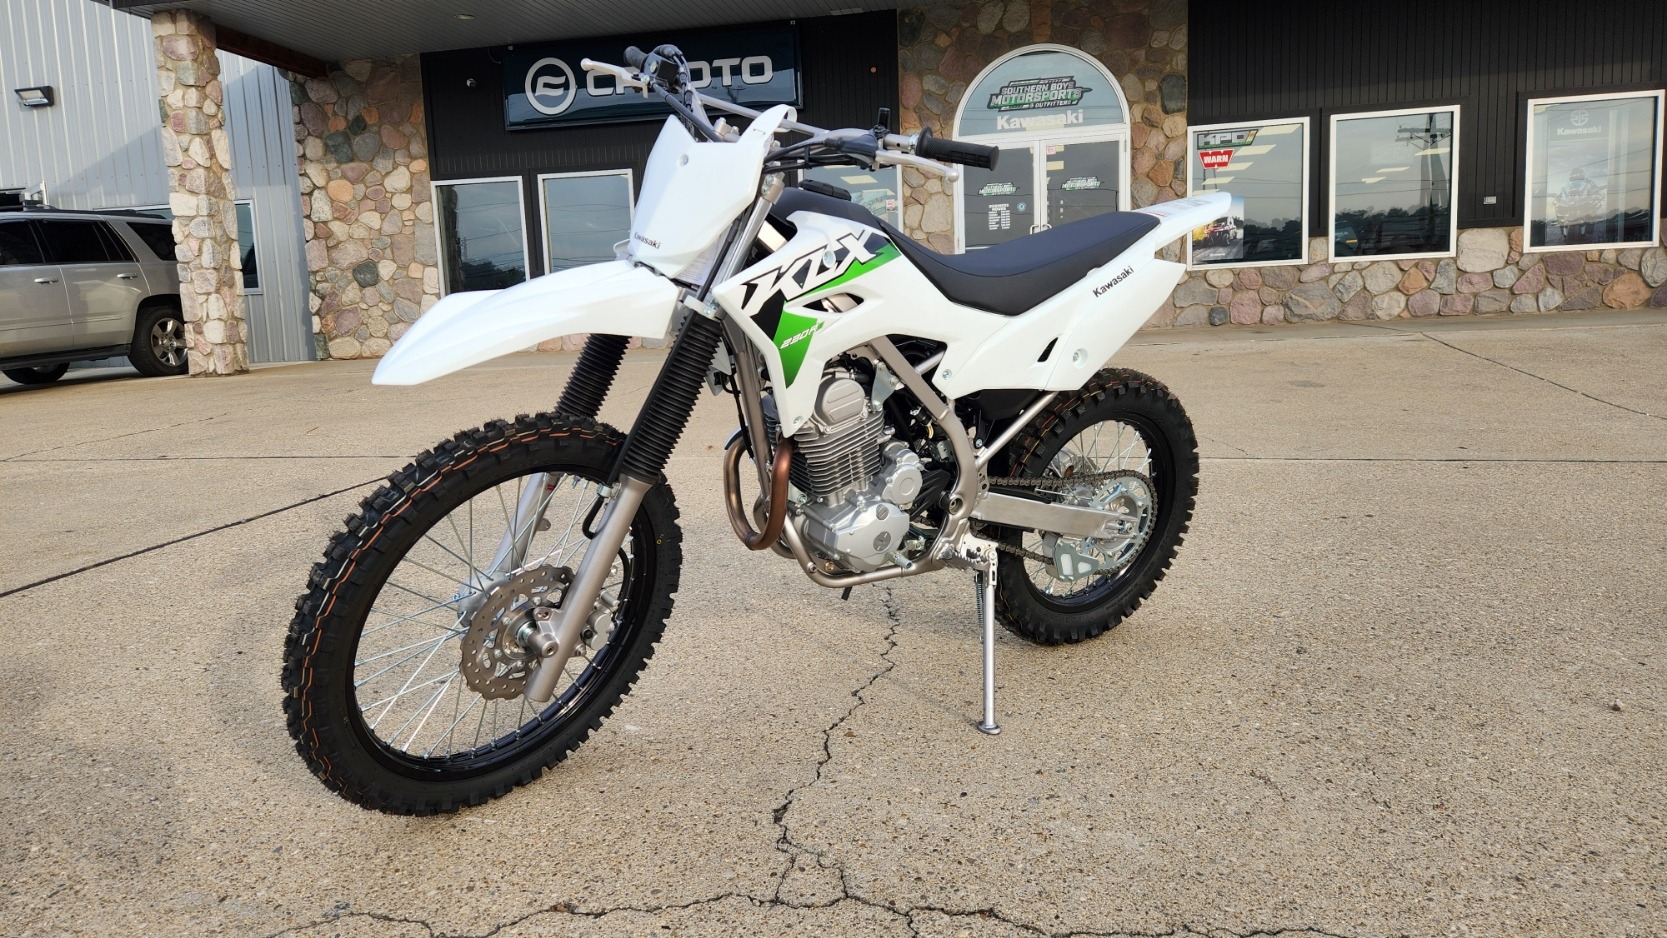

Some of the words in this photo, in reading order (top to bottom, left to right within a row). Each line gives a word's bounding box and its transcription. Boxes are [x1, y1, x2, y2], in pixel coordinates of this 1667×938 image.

[1001, 84, 1048, 95] SOUTHERN
[1050, 81, 1075, 91] BOYS
[990, 88, 1082, 106] MOTORSPORTS
[996, 109, 1084, 130] Kawasaki
[1556, 126, 1602, 136] Kawasaki
[1203, 154, 1229, 164] WARN
[1092, 265, 1135, 298] Kawasaki
